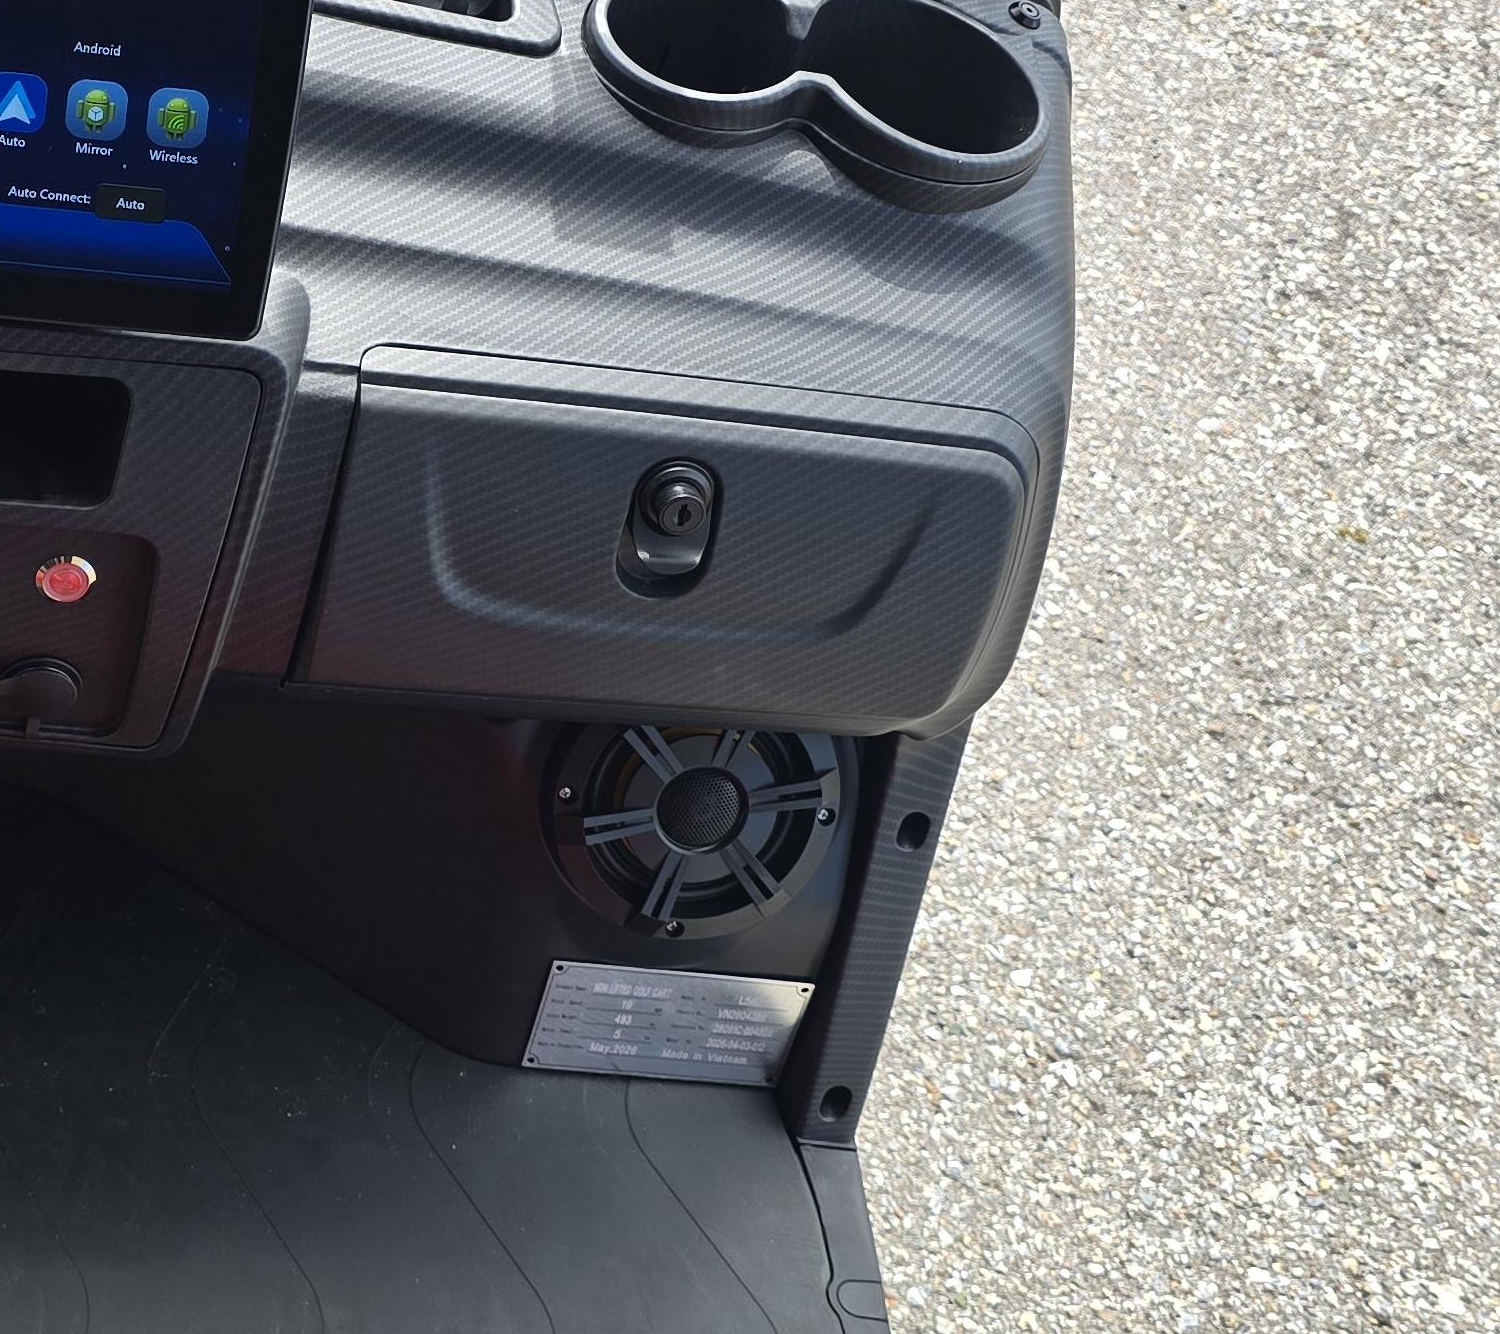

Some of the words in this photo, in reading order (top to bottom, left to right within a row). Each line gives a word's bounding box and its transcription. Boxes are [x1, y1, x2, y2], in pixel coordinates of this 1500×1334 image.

[73, 41, 122, 58] Android
[75, 141, 113, 157] Mirror
[149, 149, 198, 166] Wireless
[8, 185, 38, 200] Auto
[39, 188, 92, 206] Connect:
[115, 196, 146, 212] Auto
[661, 1048, 689, 1061] Made
[692, 1050, 703, 1061] in
[707, 1051, 748, 1065] Vietnam
